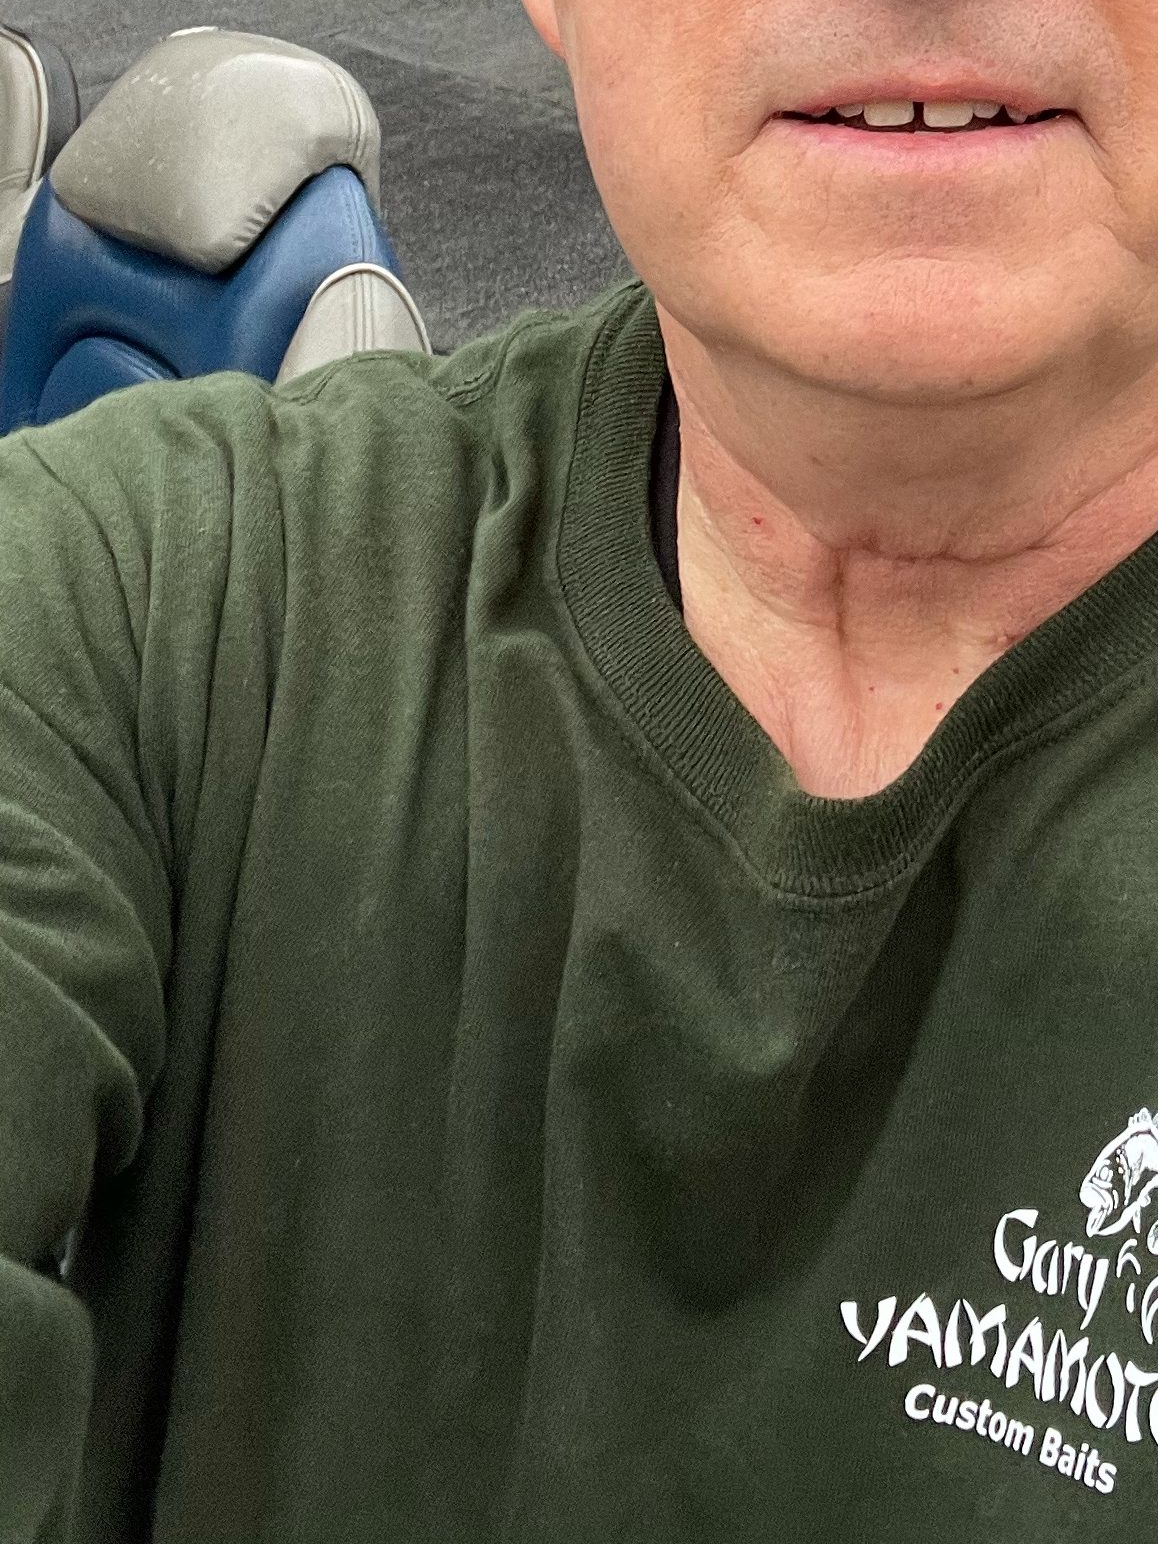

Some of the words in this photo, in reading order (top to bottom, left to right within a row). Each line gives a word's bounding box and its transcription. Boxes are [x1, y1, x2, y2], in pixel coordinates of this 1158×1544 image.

[994, 1208, 1109, 1330] Gary
[904, 1383, 1034, 1456] Custom
[1039, 1427, 1118, 1494] Baits
